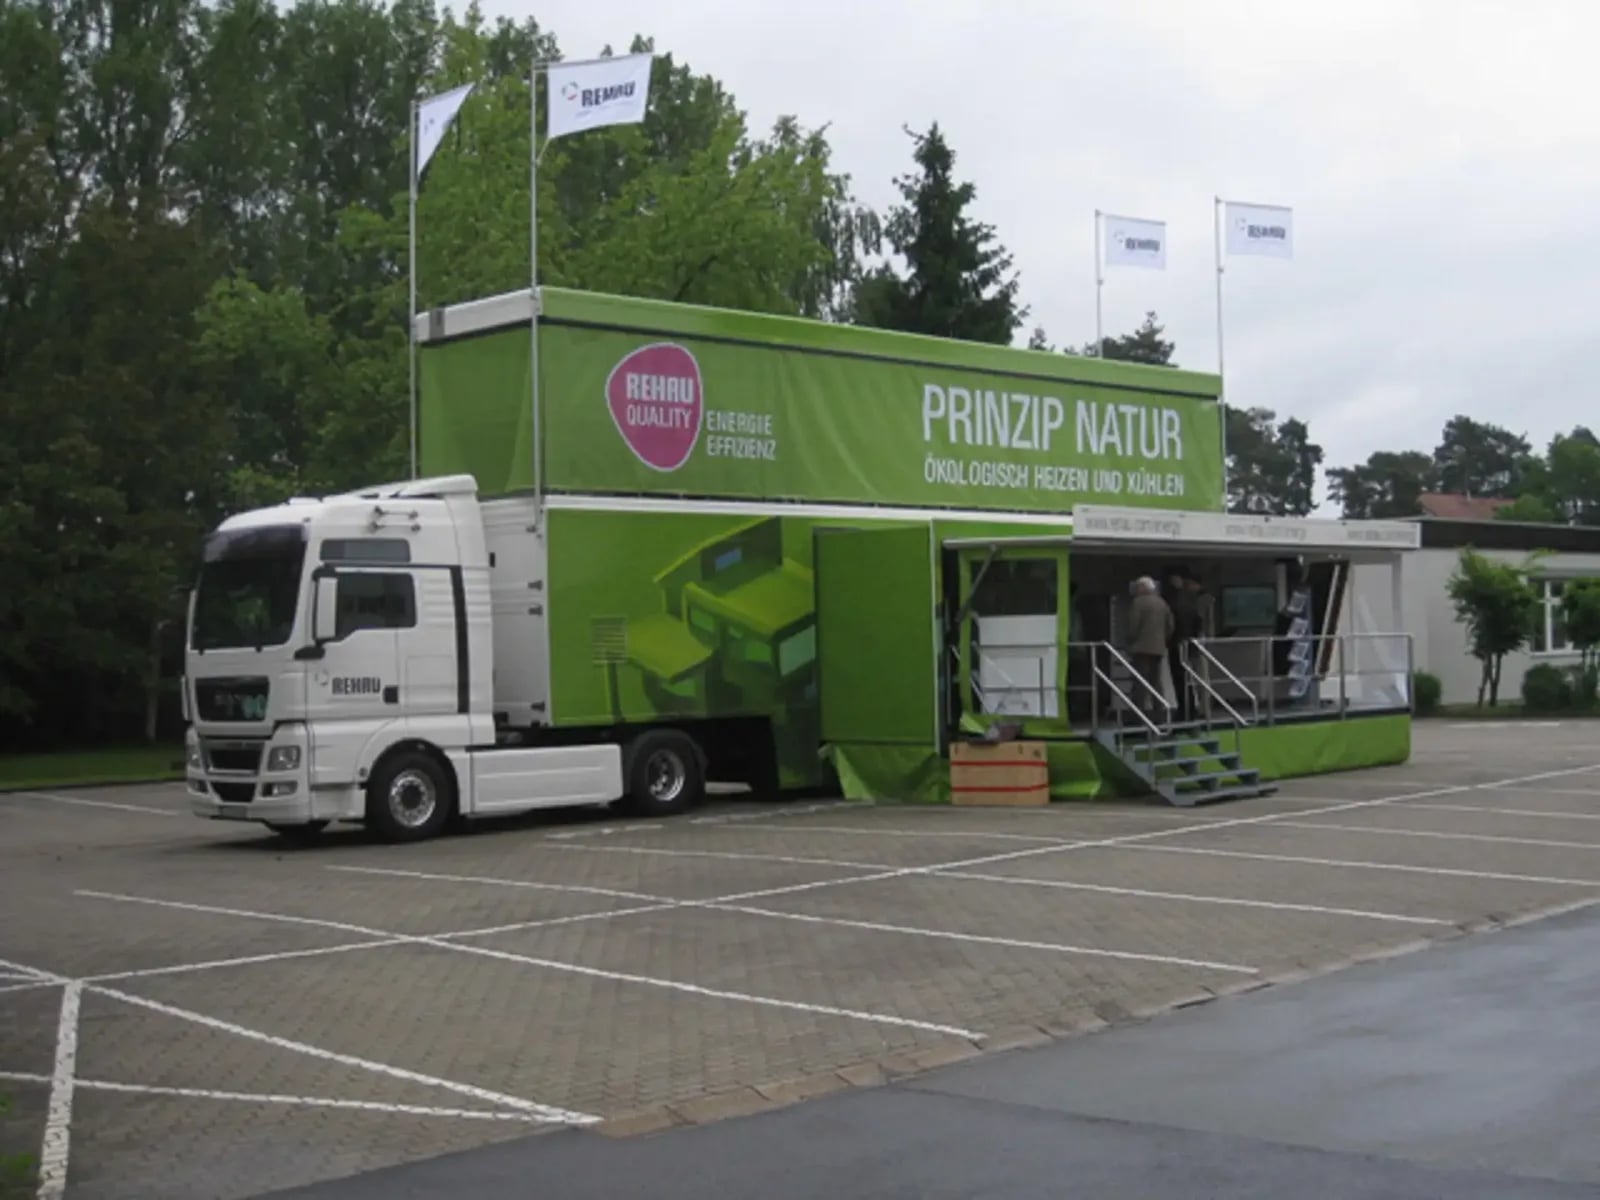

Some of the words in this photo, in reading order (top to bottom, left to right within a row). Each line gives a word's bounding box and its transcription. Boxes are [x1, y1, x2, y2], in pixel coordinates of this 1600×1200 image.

[625, 372, 695, 405] REHAU
[626, 404, 692, 429] QUALITY
[706, 410, 773, 435] ENERGIE
[922, 383, 1065, 451] PRINZIP
[1076, 399, 1184, 460] NATUR
[706, 434, 777, 460] EFFIZIENZ
[924, 452, 1029, 489] ÖKOLOGISCH
[1034, 465, 1089, 493] HEIZEN
[1094, 470, 1123, 494] UND
[1127, 467, 1185, 496] KÜHLEN
